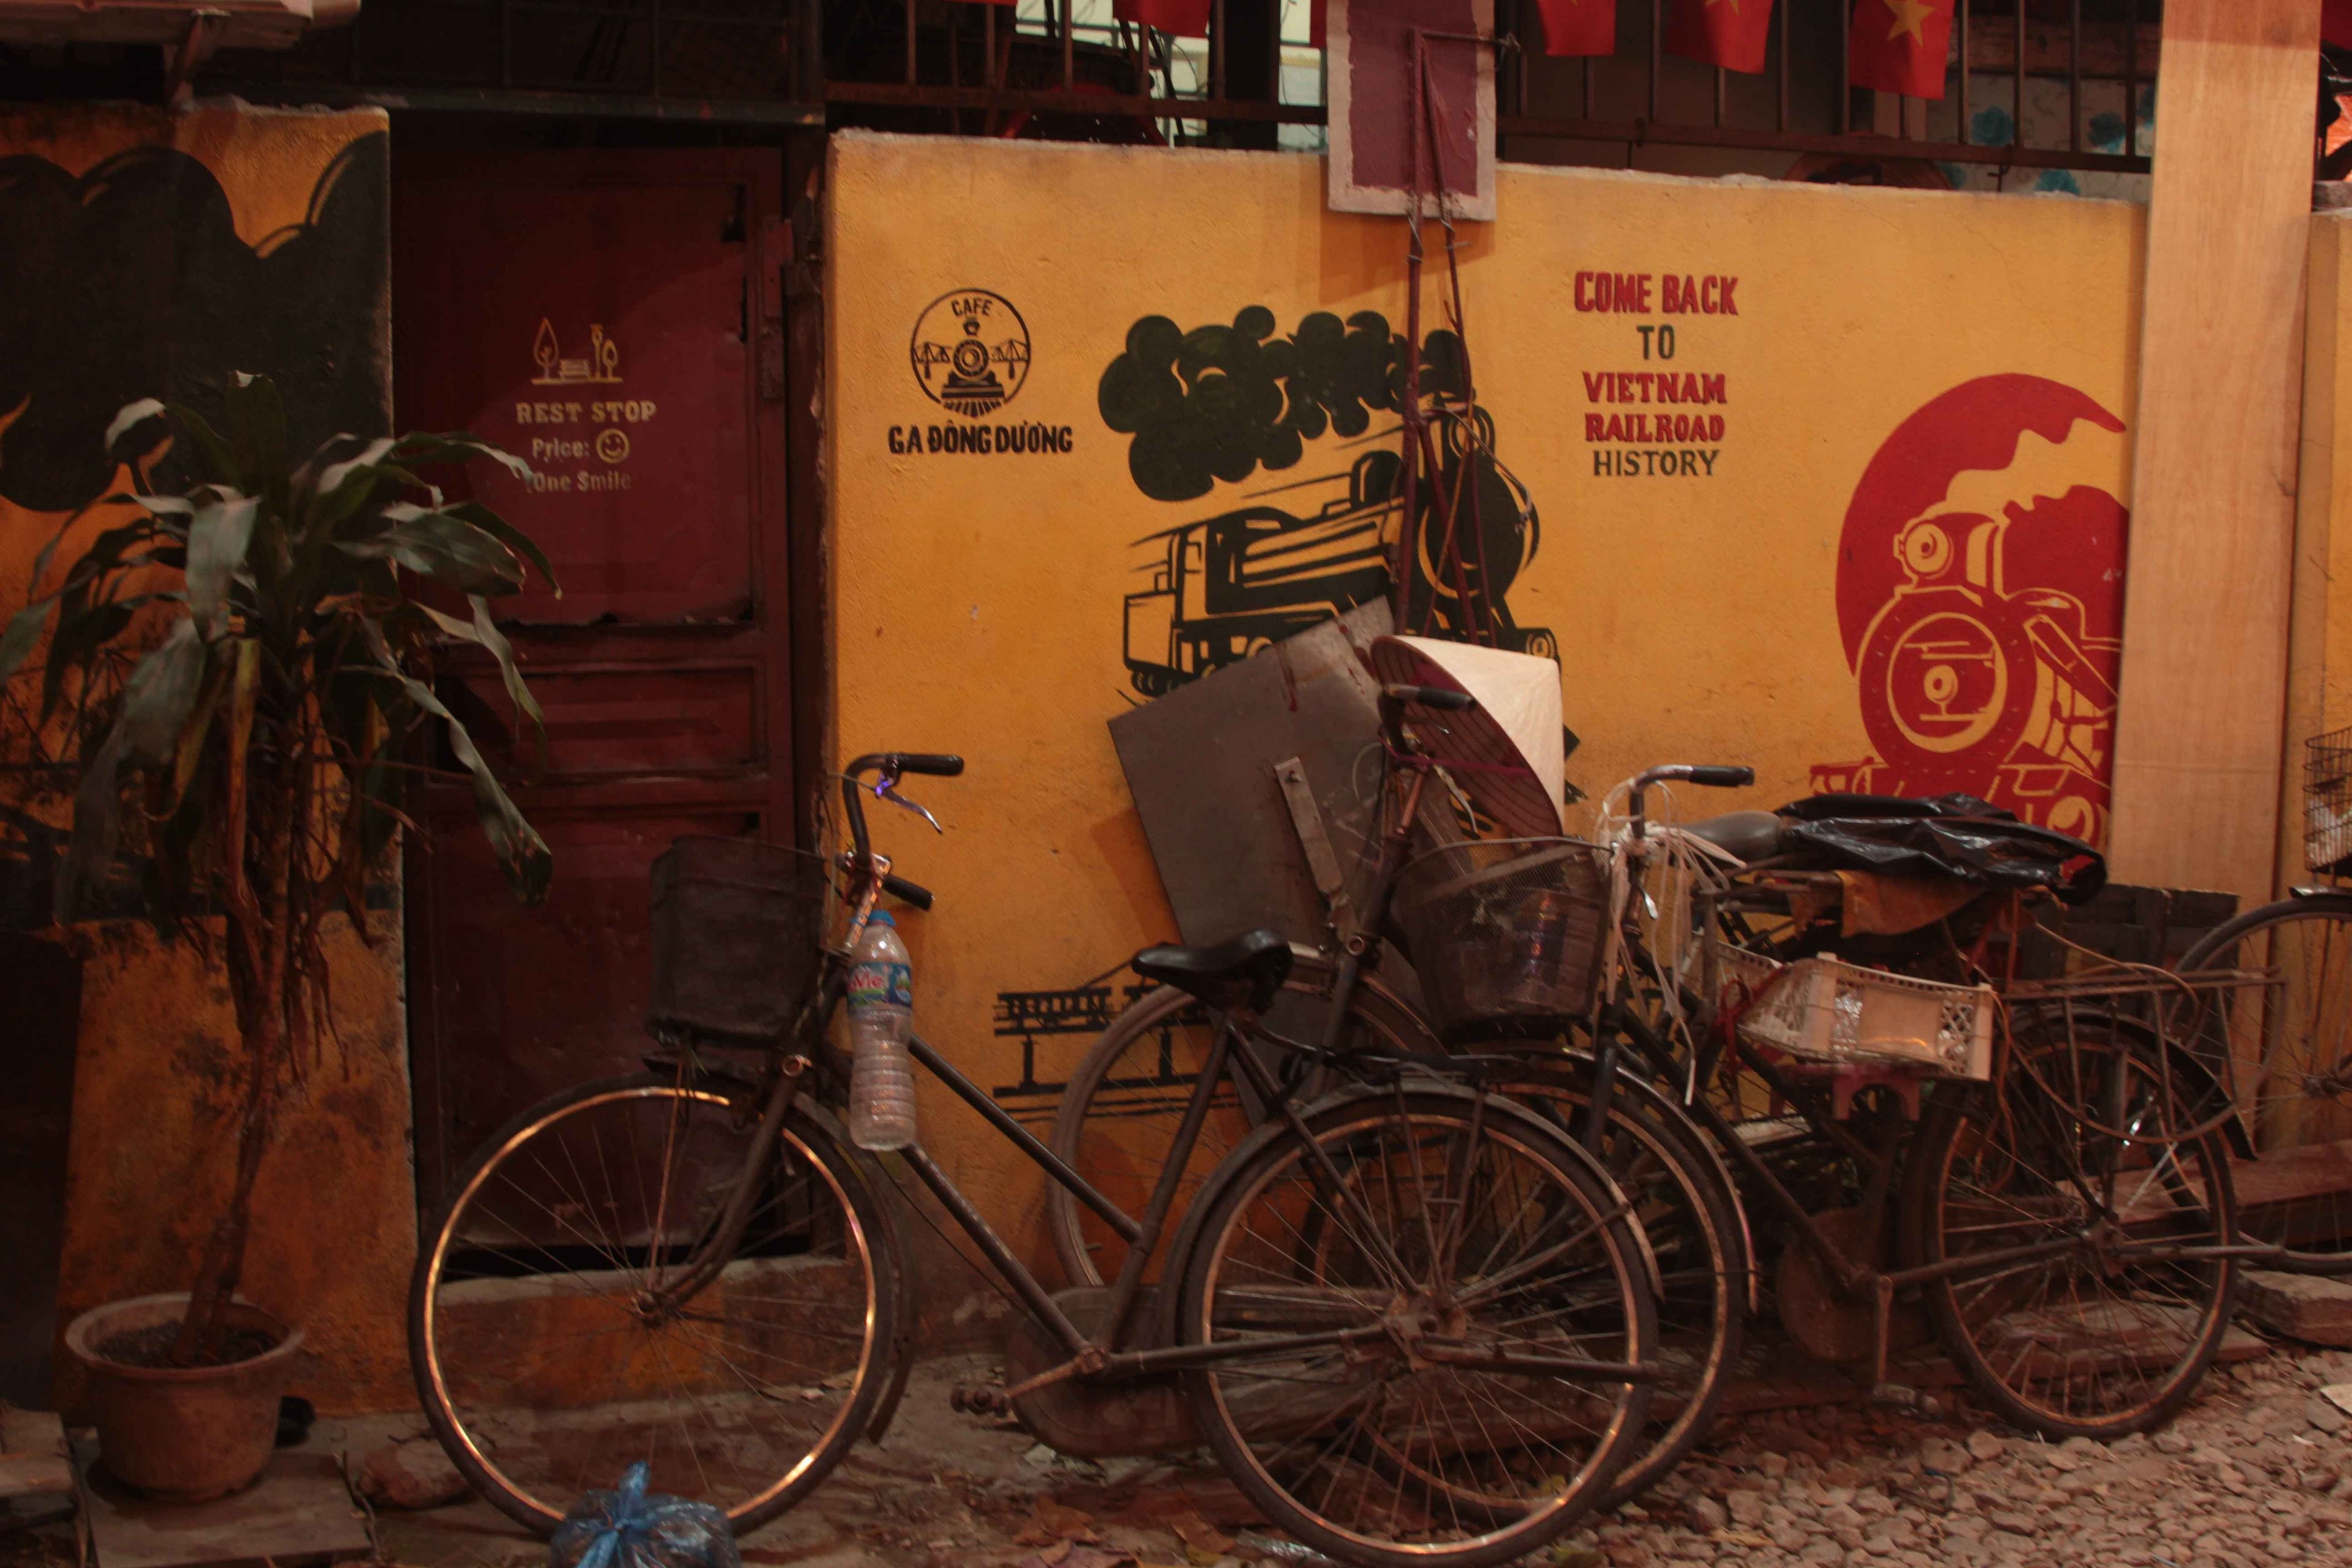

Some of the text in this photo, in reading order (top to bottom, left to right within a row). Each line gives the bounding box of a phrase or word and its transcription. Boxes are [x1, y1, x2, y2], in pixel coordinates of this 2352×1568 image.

[951, 298, 993, 317] CAFE
[1574, 271, 1739, 316] COME BACK
[1636, 323, 1676, 360] TO
[1581, 371, 1728, 405] VIETNAM
[516, 399, 657, 424] REST STOP
[888, 424, 924, 454] GA
[1584, 412, 1725, 443] RAILROAD
[1593, 448, 1721, 477] HISTORY
[532, 469, 631, 492] One Smile
